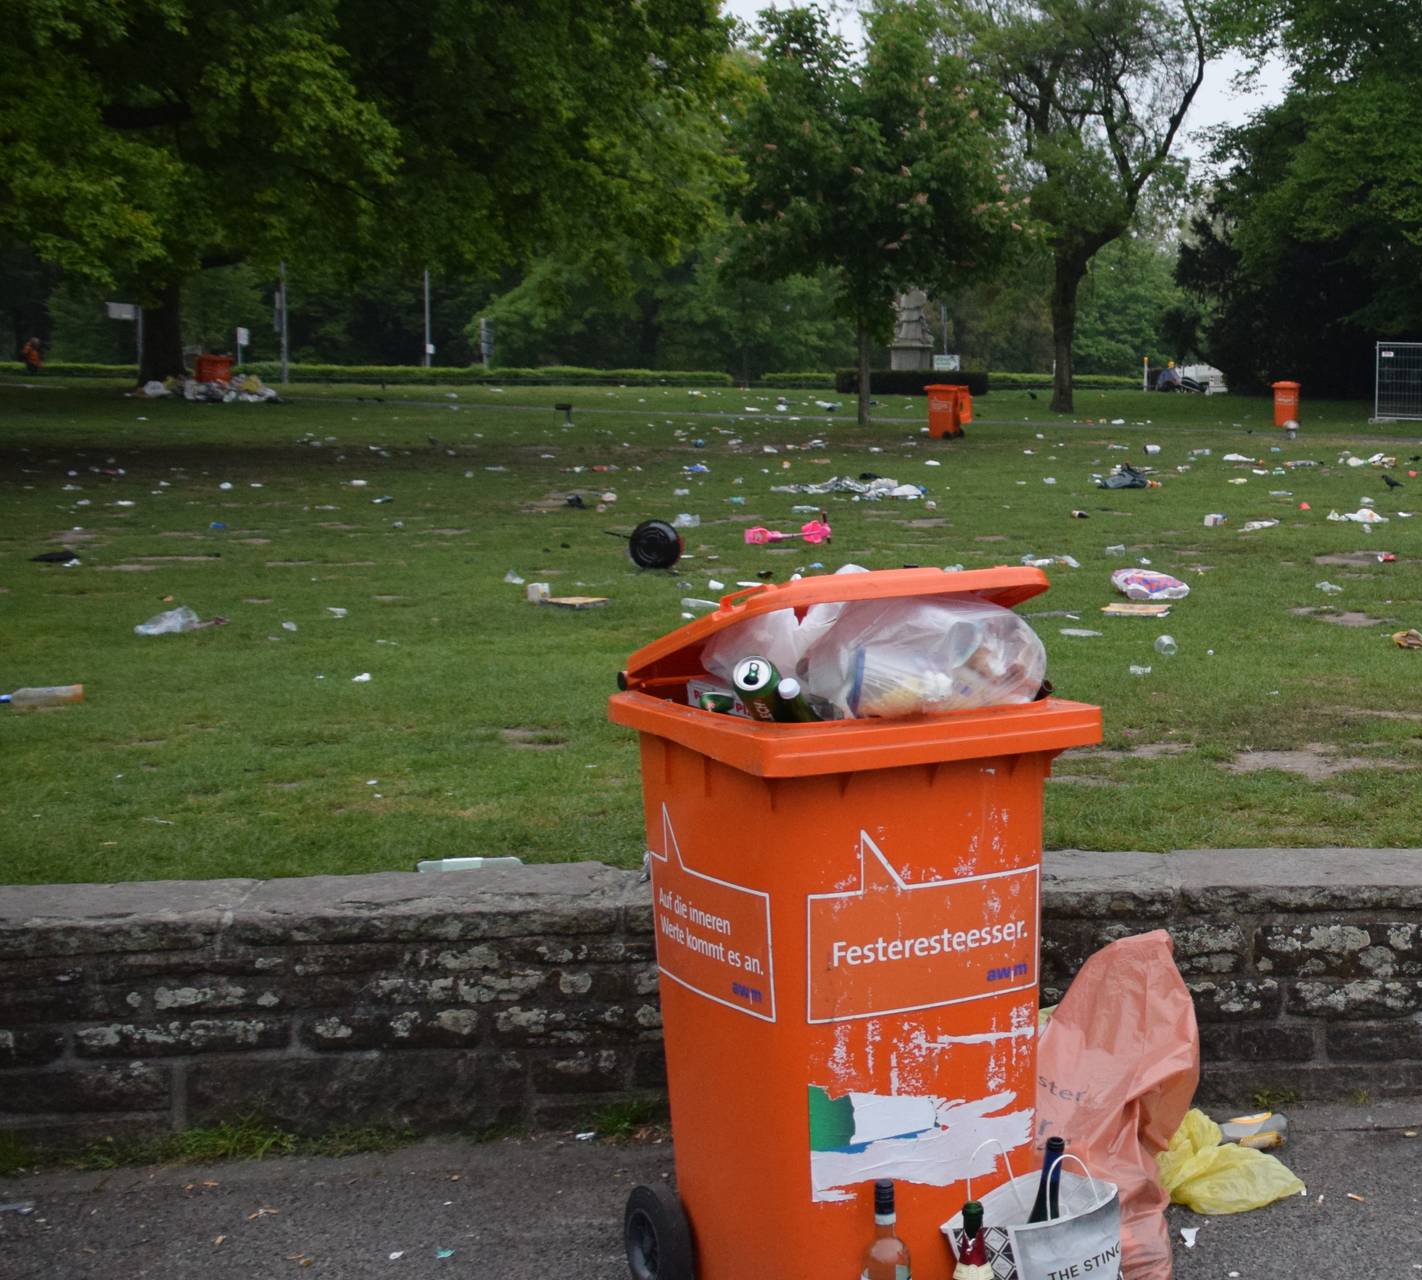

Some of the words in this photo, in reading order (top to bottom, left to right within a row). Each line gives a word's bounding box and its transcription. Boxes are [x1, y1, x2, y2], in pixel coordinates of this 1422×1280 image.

[659, 887, 673, 910] Auf
[674, 895, 688, 919] die
[689, 901, 731, 936] inneren
[660, 914, 685, 945] Werte
[686, 927, 726, 962] kommt
[728, 950, 742, 968] es
[744, 955, 765, 976] an.
[832, 920, 1028, 967] Festeresteesser.
[1048, 1264, 1080, 1280] THE
